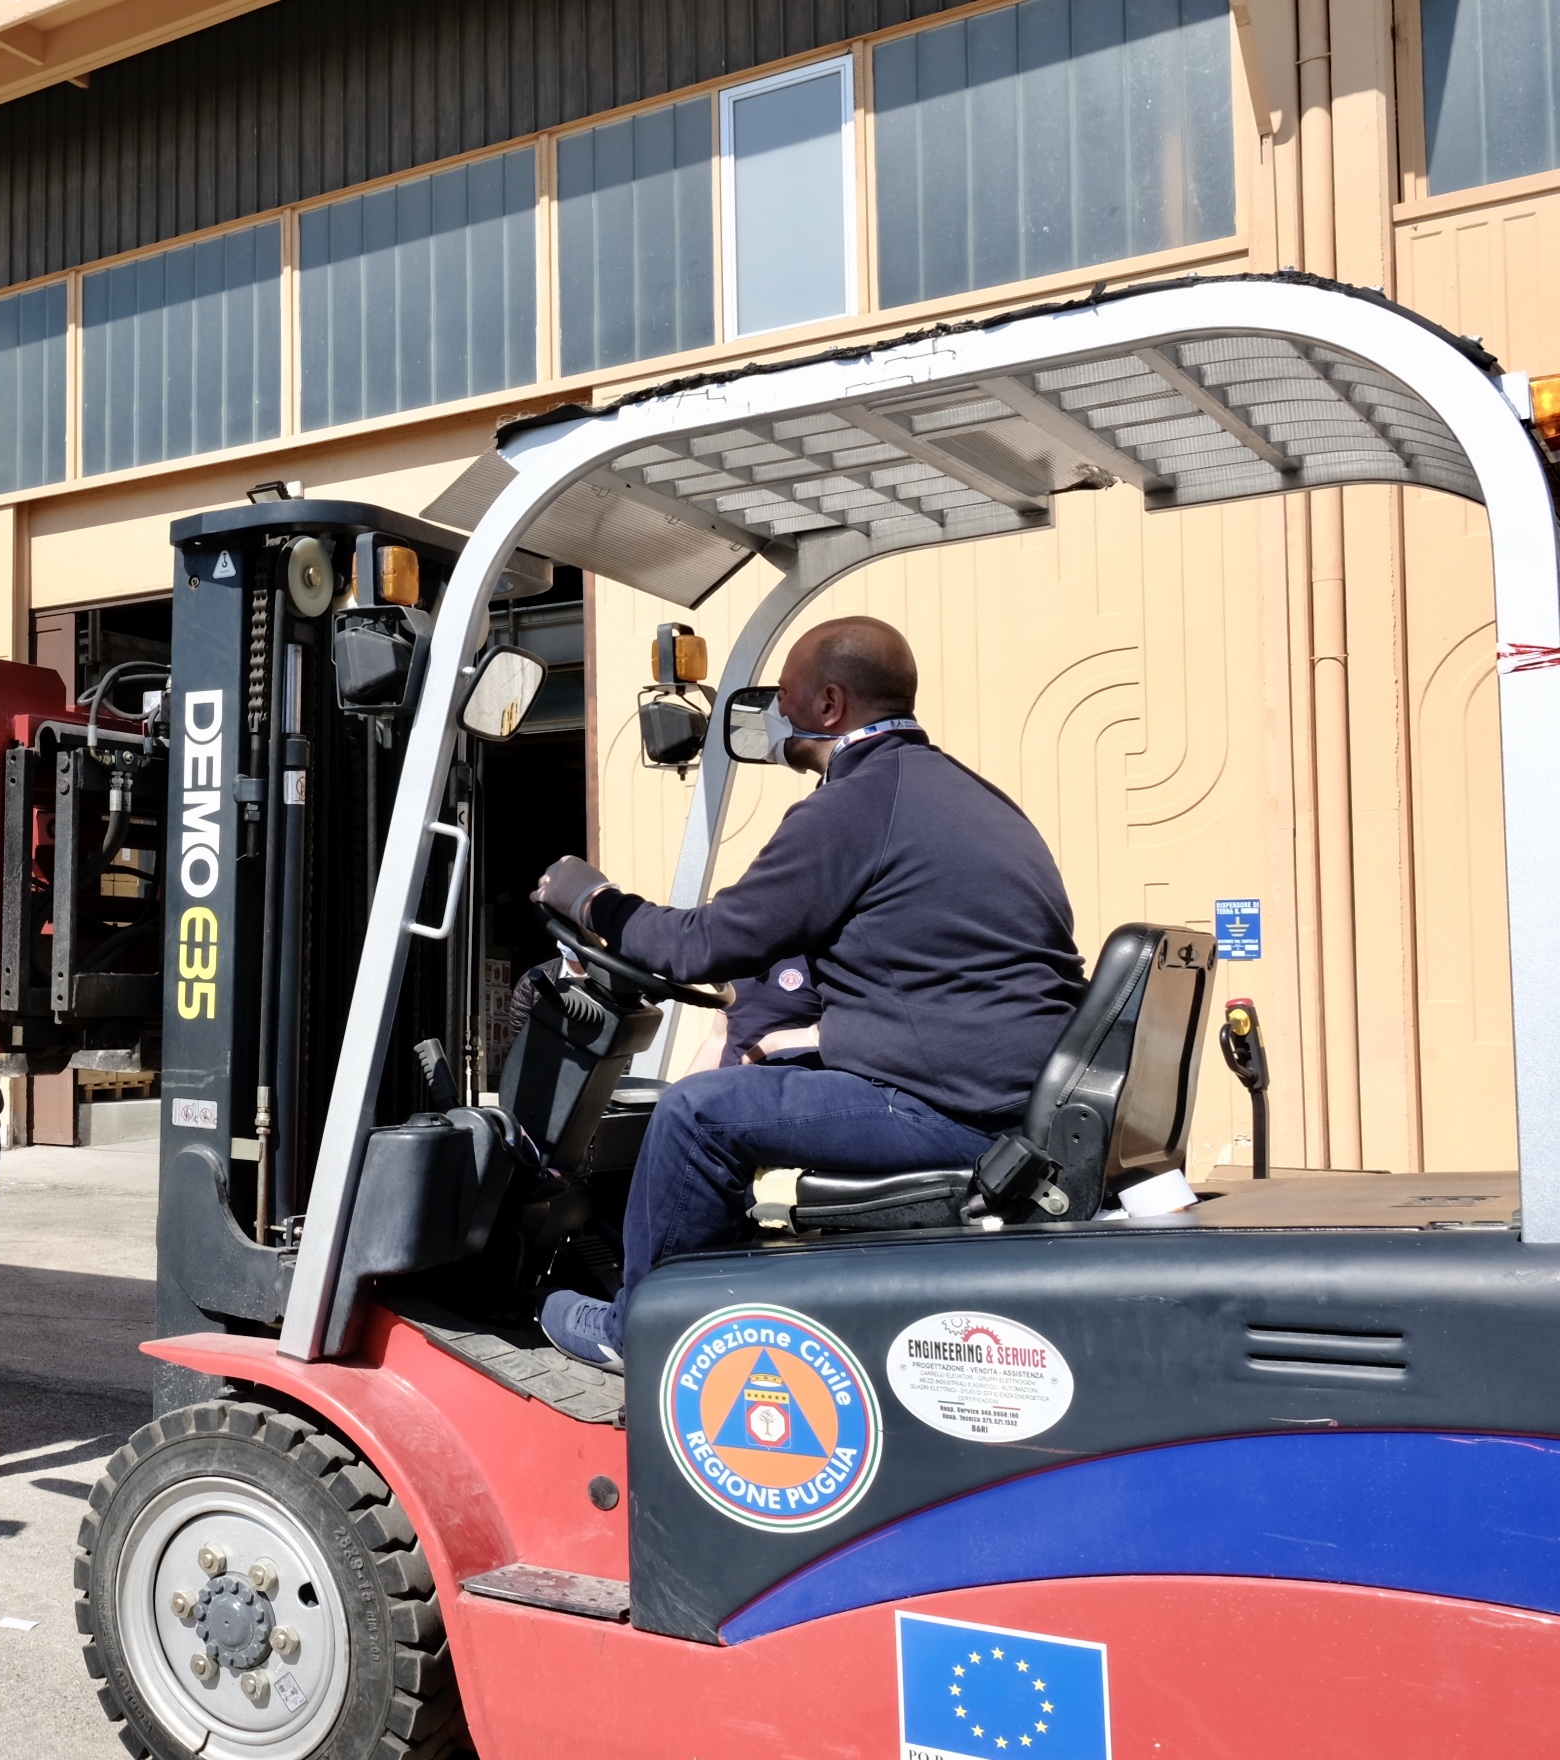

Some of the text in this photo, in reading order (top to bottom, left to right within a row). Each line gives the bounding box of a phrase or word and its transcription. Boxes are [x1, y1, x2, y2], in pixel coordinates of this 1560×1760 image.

[177, 688, 223, 1019] DEMO E35
[680, 1324, 851, 1406] Protezione Civile
[908, 1339, 1047, 1368] ENGINEERING & SERVICE
[912, 1361, 965, 1373] PROGETTAZIONE
[970, 1367, 997, 1376] VENDITA
[1003, 1370, 1044, 1380] ASSISTENZA
[971, 1424, 988, 1433] BARI
[686, 1430, 857, 1509] REGIONE PUGLIA
